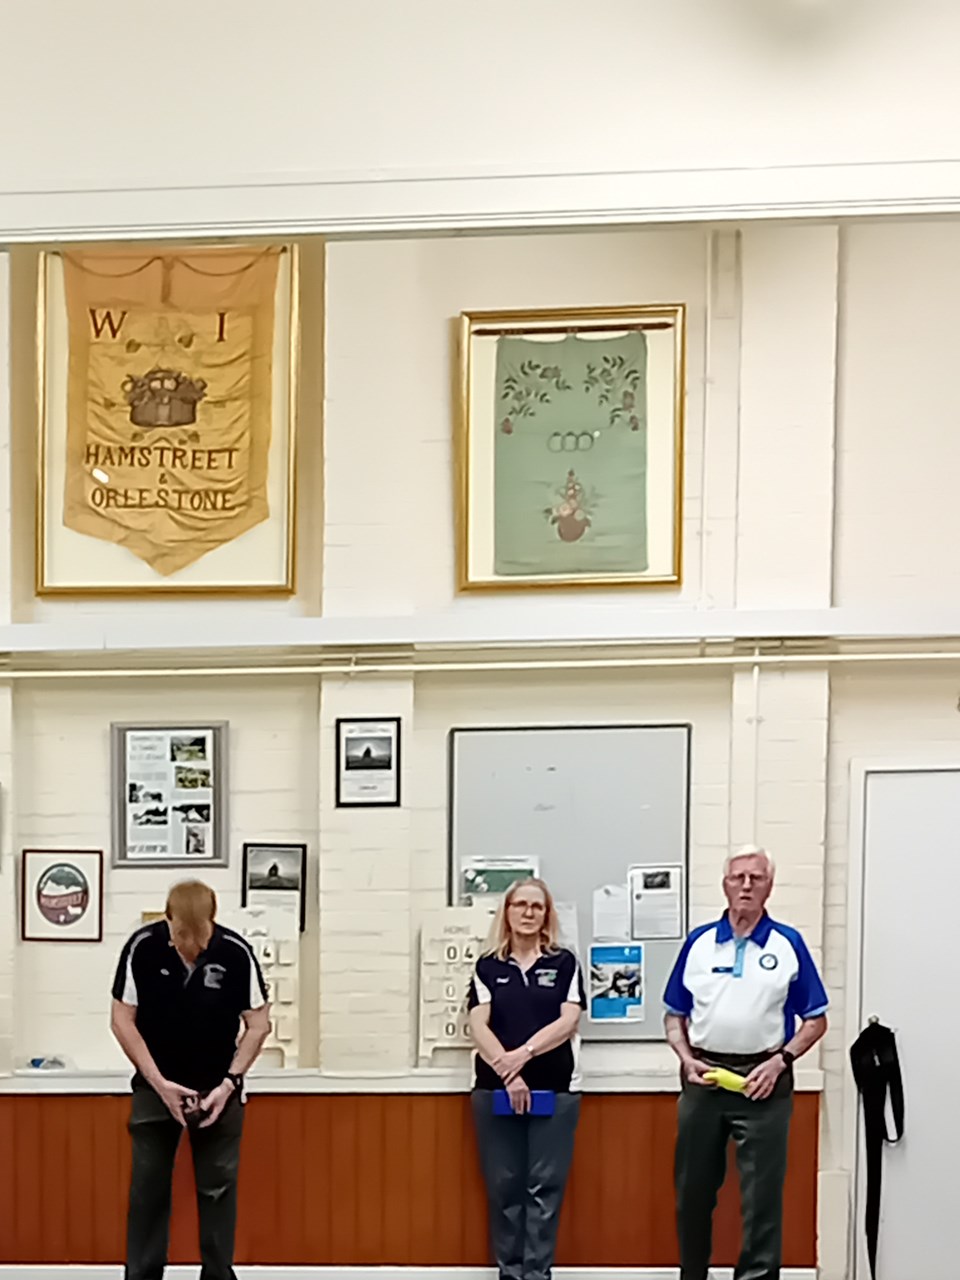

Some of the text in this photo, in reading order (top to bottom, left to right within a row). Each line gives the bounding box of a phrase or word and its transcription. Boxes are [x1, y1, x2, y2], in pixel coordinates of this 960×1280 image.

[89, 308, 228, 343] W I
[84, 443, 240, 471] HAMSTREET
[158, 472, 169, 485] &
[91, 486, 237, 512] ORLESTONE
